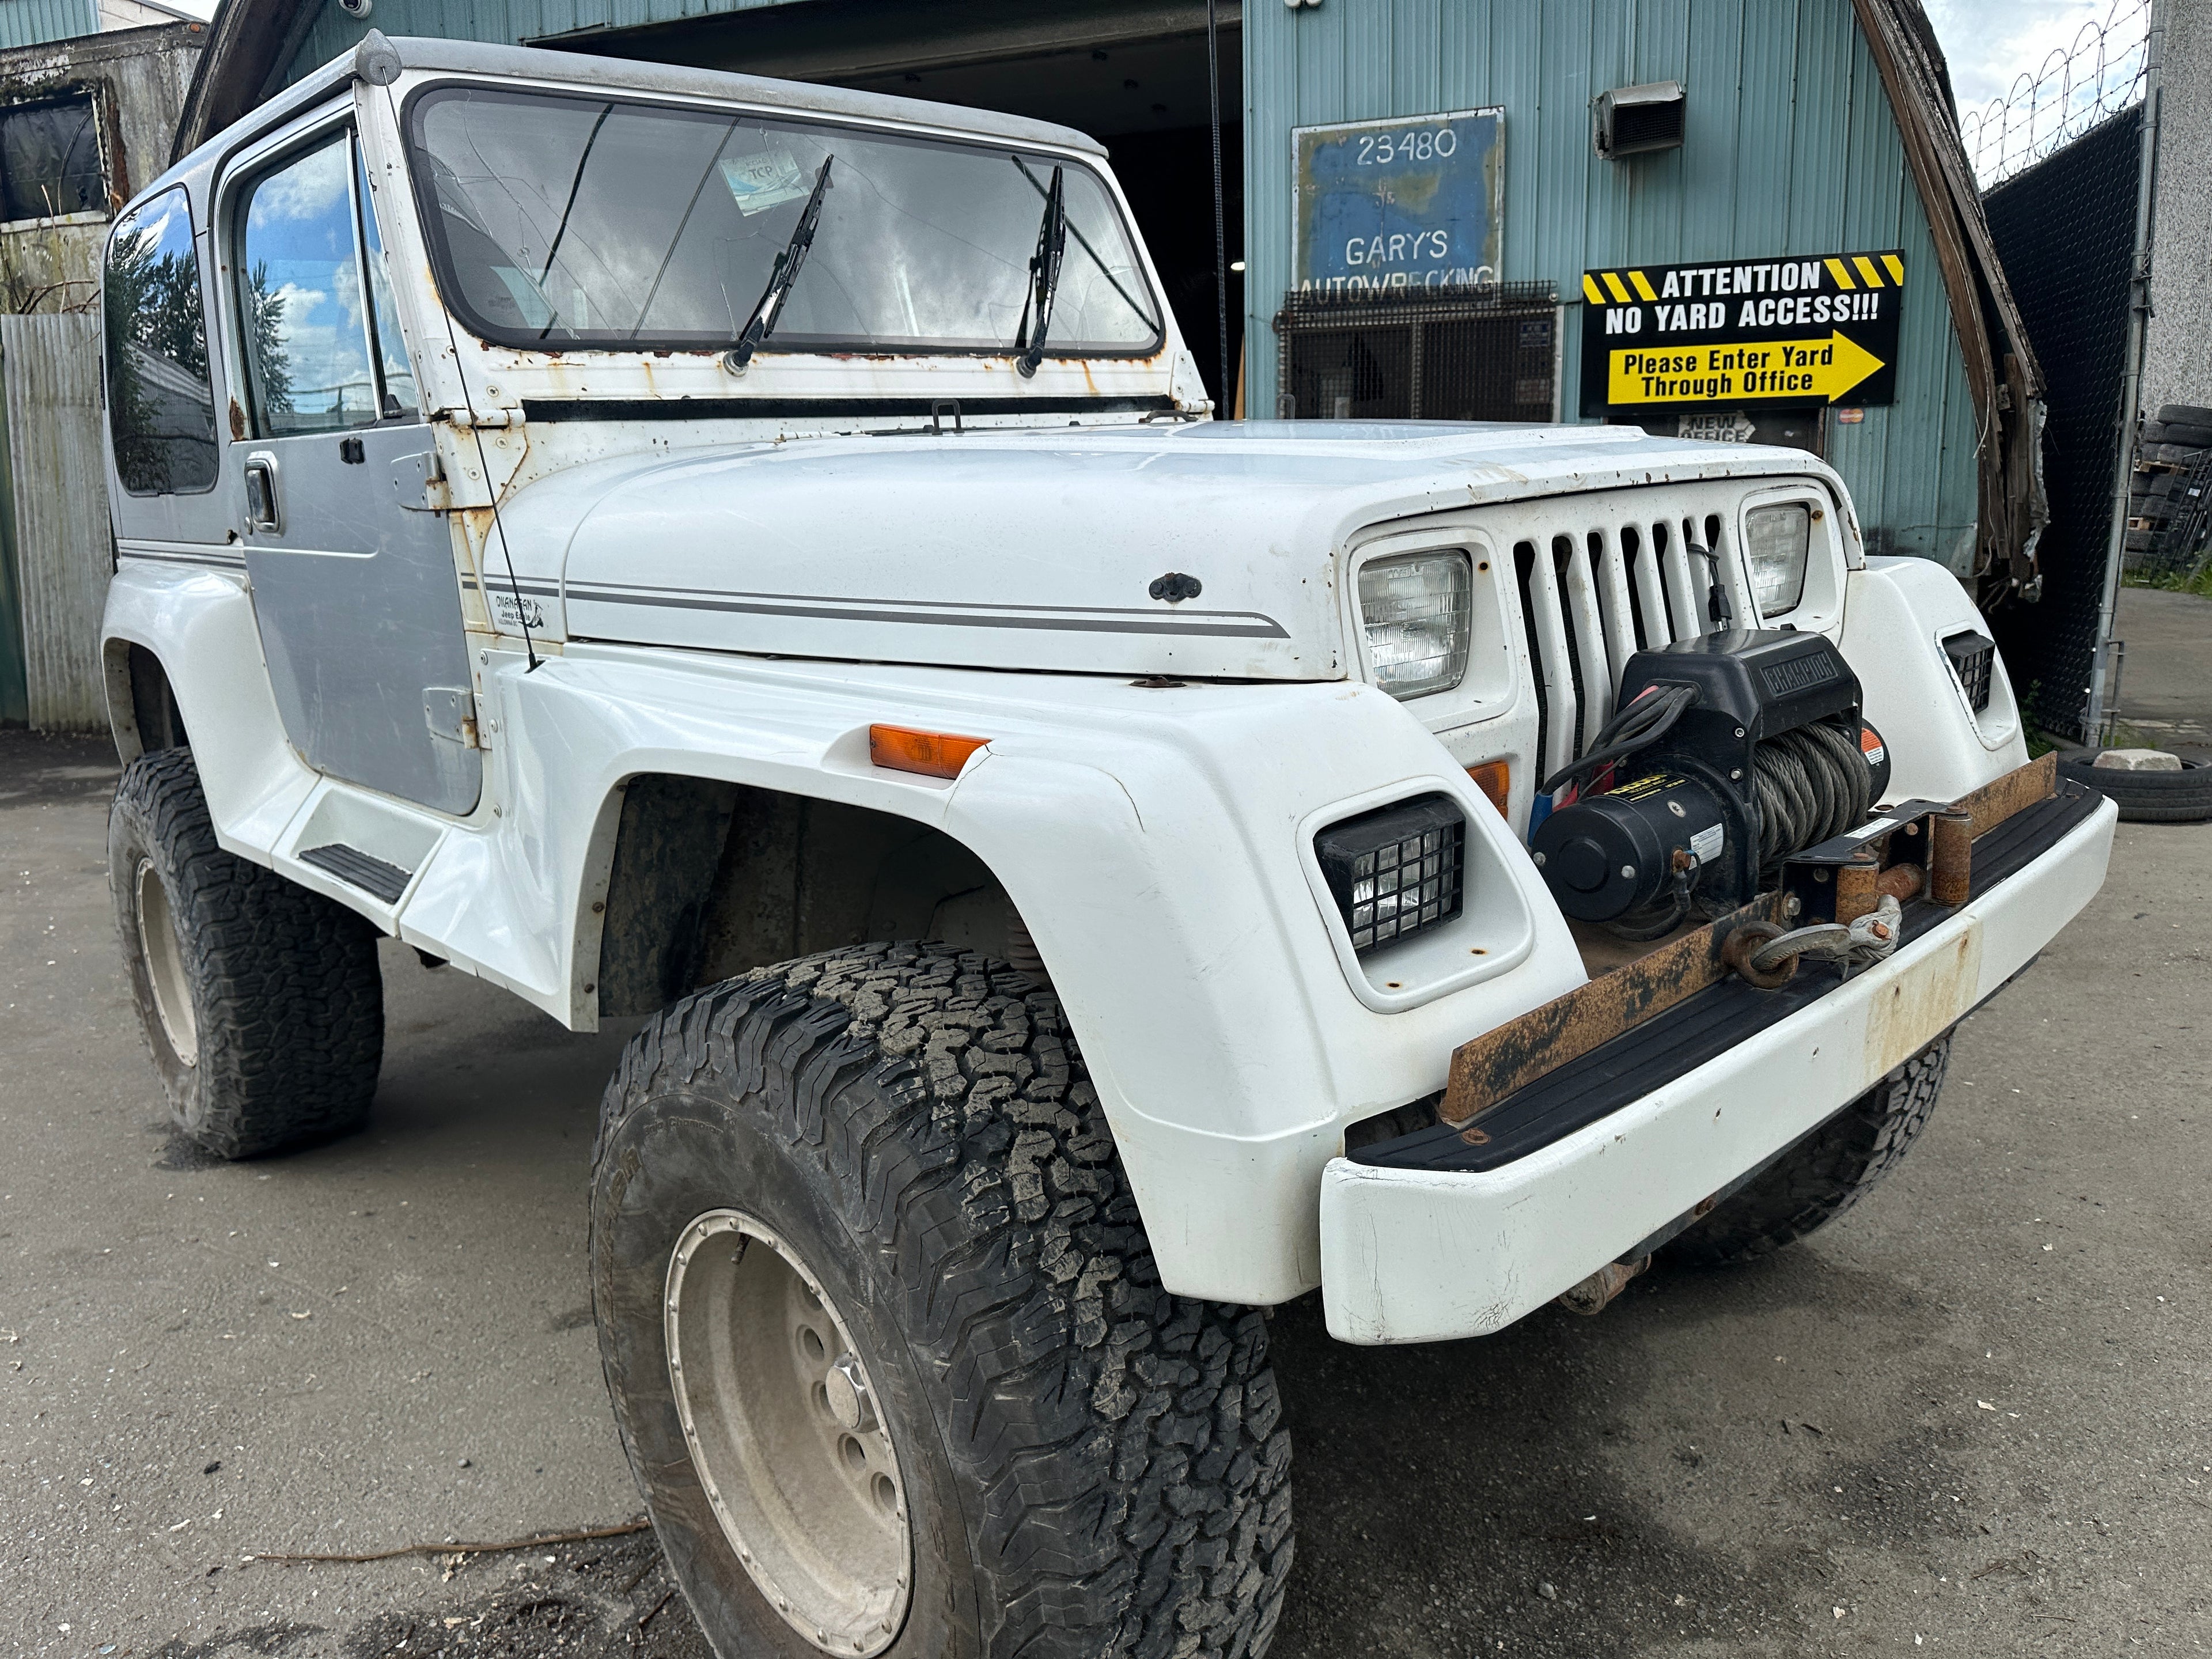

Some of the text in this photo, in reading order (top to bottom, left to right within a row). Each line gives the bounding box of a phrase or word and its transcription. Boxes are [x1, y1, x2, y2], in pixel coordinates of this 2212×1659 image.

[1357, 128, 1457, 165] 23480
[1346, 230, 1448, 265] GARY'S
[1661, 261, 1820, 298] ATTENTION
[1605, 292, 1878, 334] NO YARD ACCESS!!!
[1624, 343, 1833, 375] Please Enter Yard
[1642, 370, 1813, 399] Through Office
[1681, 429, 1747, 443] OFFICE
[1691, 415, 1736, 430] NEW
[496, 596, 532, 611] OKANAAN
[502, 610, 531, 621] Jeep Eale
[1765, 653, 1833, 693] CHAMPION
